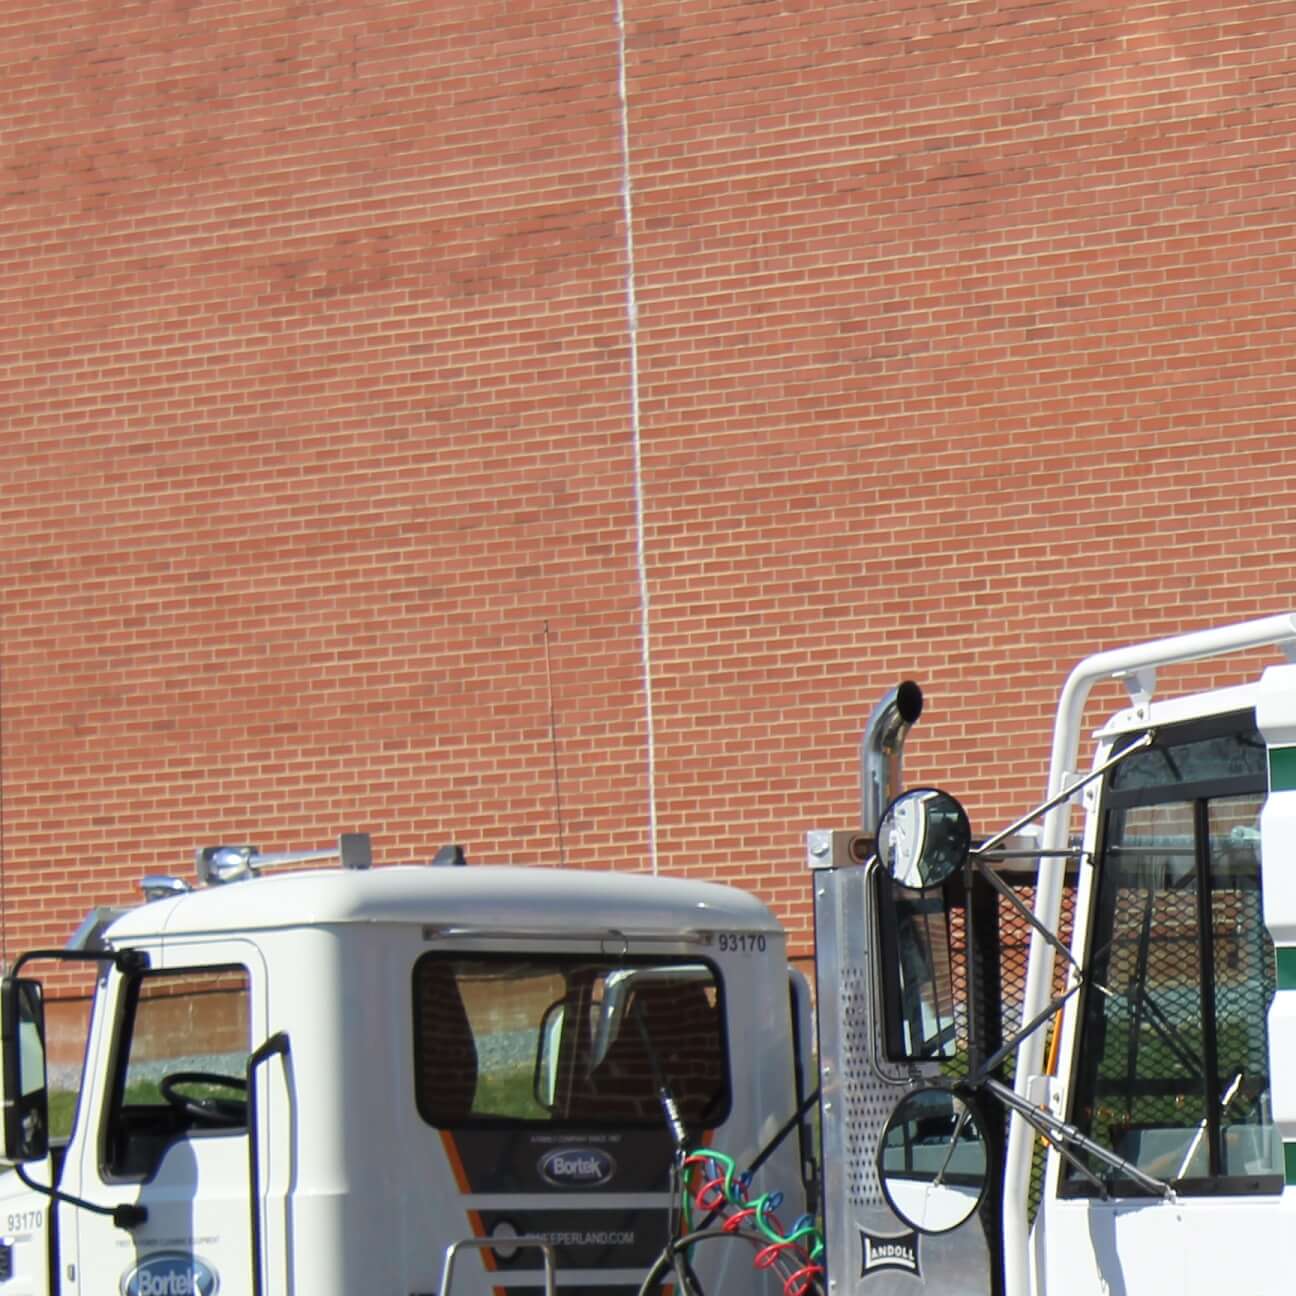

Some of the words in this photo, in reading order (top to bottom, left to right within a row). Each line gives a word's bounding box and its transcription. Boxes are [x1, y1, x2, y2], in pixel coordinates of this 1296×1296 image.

[719, 933, 767, 952] 93170
[553, 1157, 603, 1178] Bortek
[8, 1210, 43, 1232] 93170
[865, 1237, 916, 1269] LANDOLL
